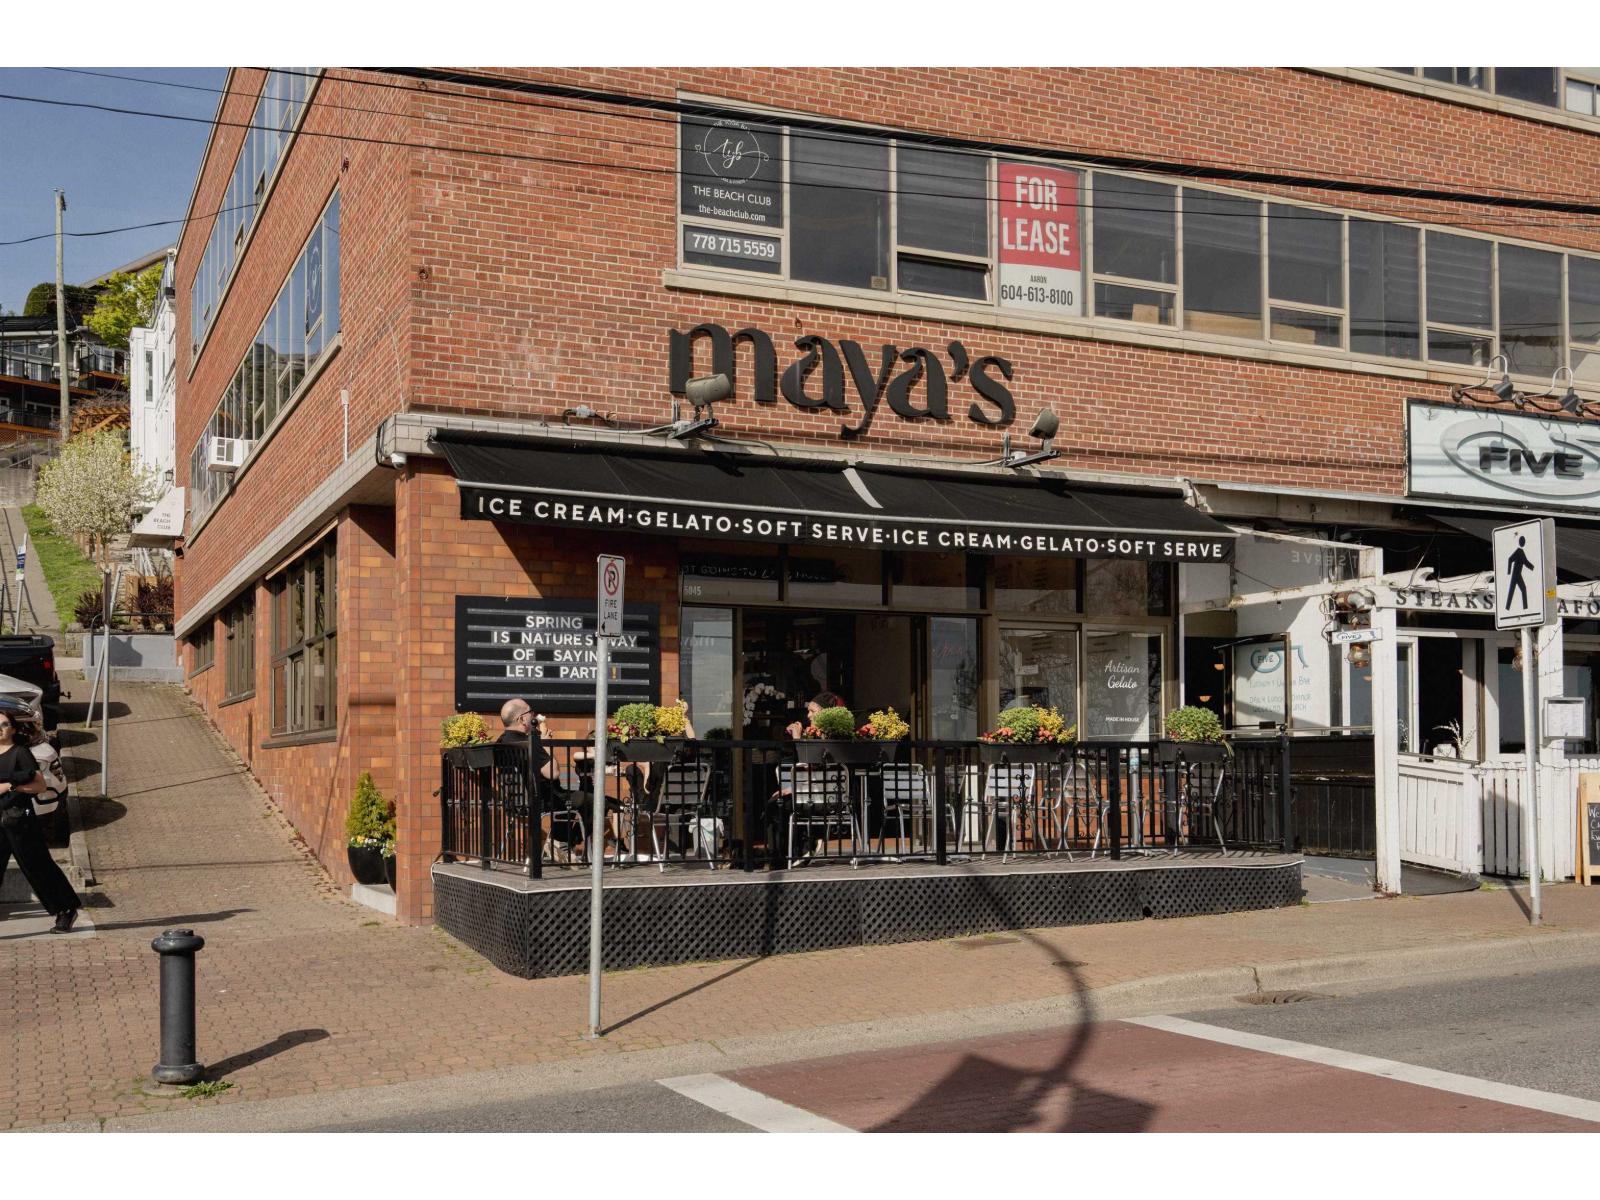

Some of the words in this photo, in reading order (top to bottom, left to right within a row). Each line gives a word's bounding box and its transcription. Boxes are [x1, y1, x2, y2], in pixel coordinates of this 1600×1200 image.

[692, 185, 711, 197] THE
[713, 188, 745, 202] BEACH
[747, 193, 772, 206] CLUB
[1015, 175, 1058, 212] FOR
[698, 204, 766, 222] the-beachclub.com
[692, 233, 716, 250] 778
[718, 237, 741, 253] 715
[743, 240, 775, 258] 5559
[1002, 217, 1071, 256] LEASE
[1000, 284, 1073, 306] 604-613-8100
[668, 322, 1017, 439] maya's
[1479, 446, 1585, 479] FIVE
[478, 496, 522, 516] ICE
[534, 501, 624, 524] CREAM
[637, 510, 731, 532] GELATO
[742, 518, 802, 537] SOFT
[812, 523, 883, 543] SERVE
[893, 528, 928, 546] ICE
[938, 531, 1011, 549] CREAM
[1020, 535, 1099, 553] GELATO
[1107, 539, 1156, 555] SOFT
[1163, 541, 1222, 558] SERVE
[604, 598, 617, 609] FIRE
[1395, 589, 1494, 609] STEAKS
[525, 615, 583, 630] SPRING
[603, 611, 618, 621] LANE
[493, 631, 510, 644] IS
[513, 648, 535, 661] OF
[506, 665, 544, 678] LETS
[1104, 659, 1140, 674] Artisan
[1107, 674, 1138, 689] Gelato
